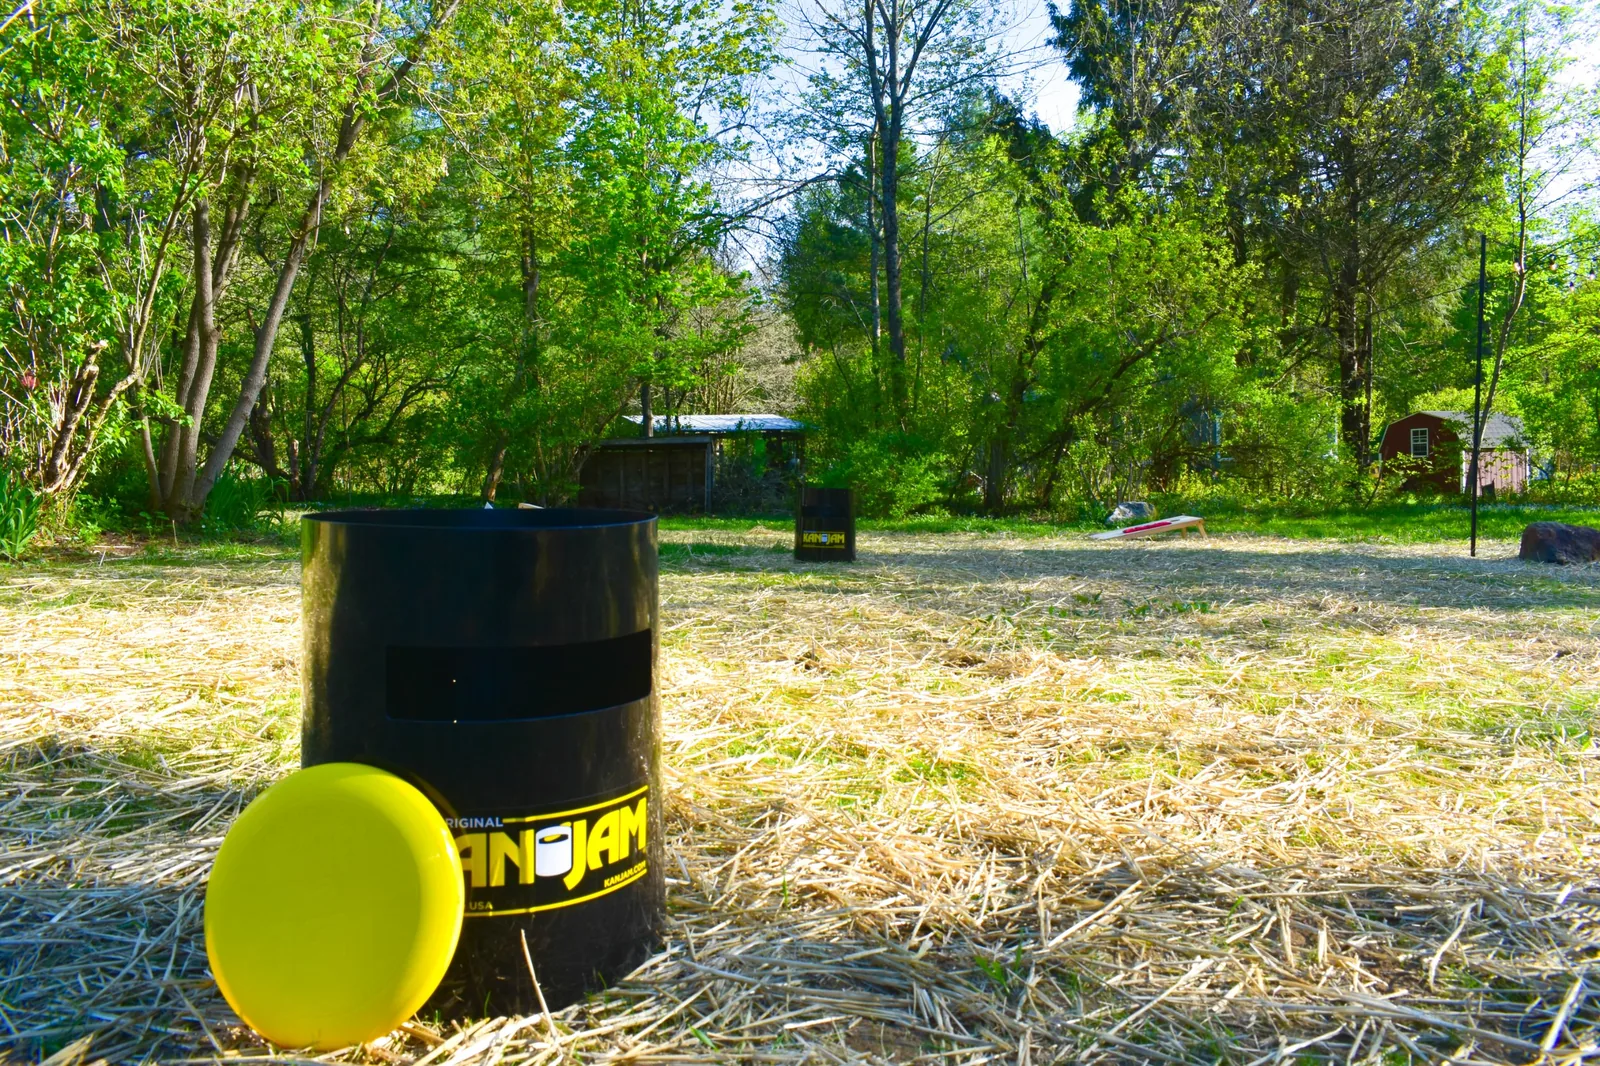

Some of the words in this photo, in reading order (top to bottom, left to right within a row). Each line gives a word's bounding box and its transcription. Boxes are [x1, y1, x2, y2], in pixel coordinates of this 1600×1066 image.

[446, 817, 504, 828] RIGINAL
[453, 829, 535, 888] AN
[604, 860, 646, 888] KANJAM.COM
[469, 901, 493, 910] USA
